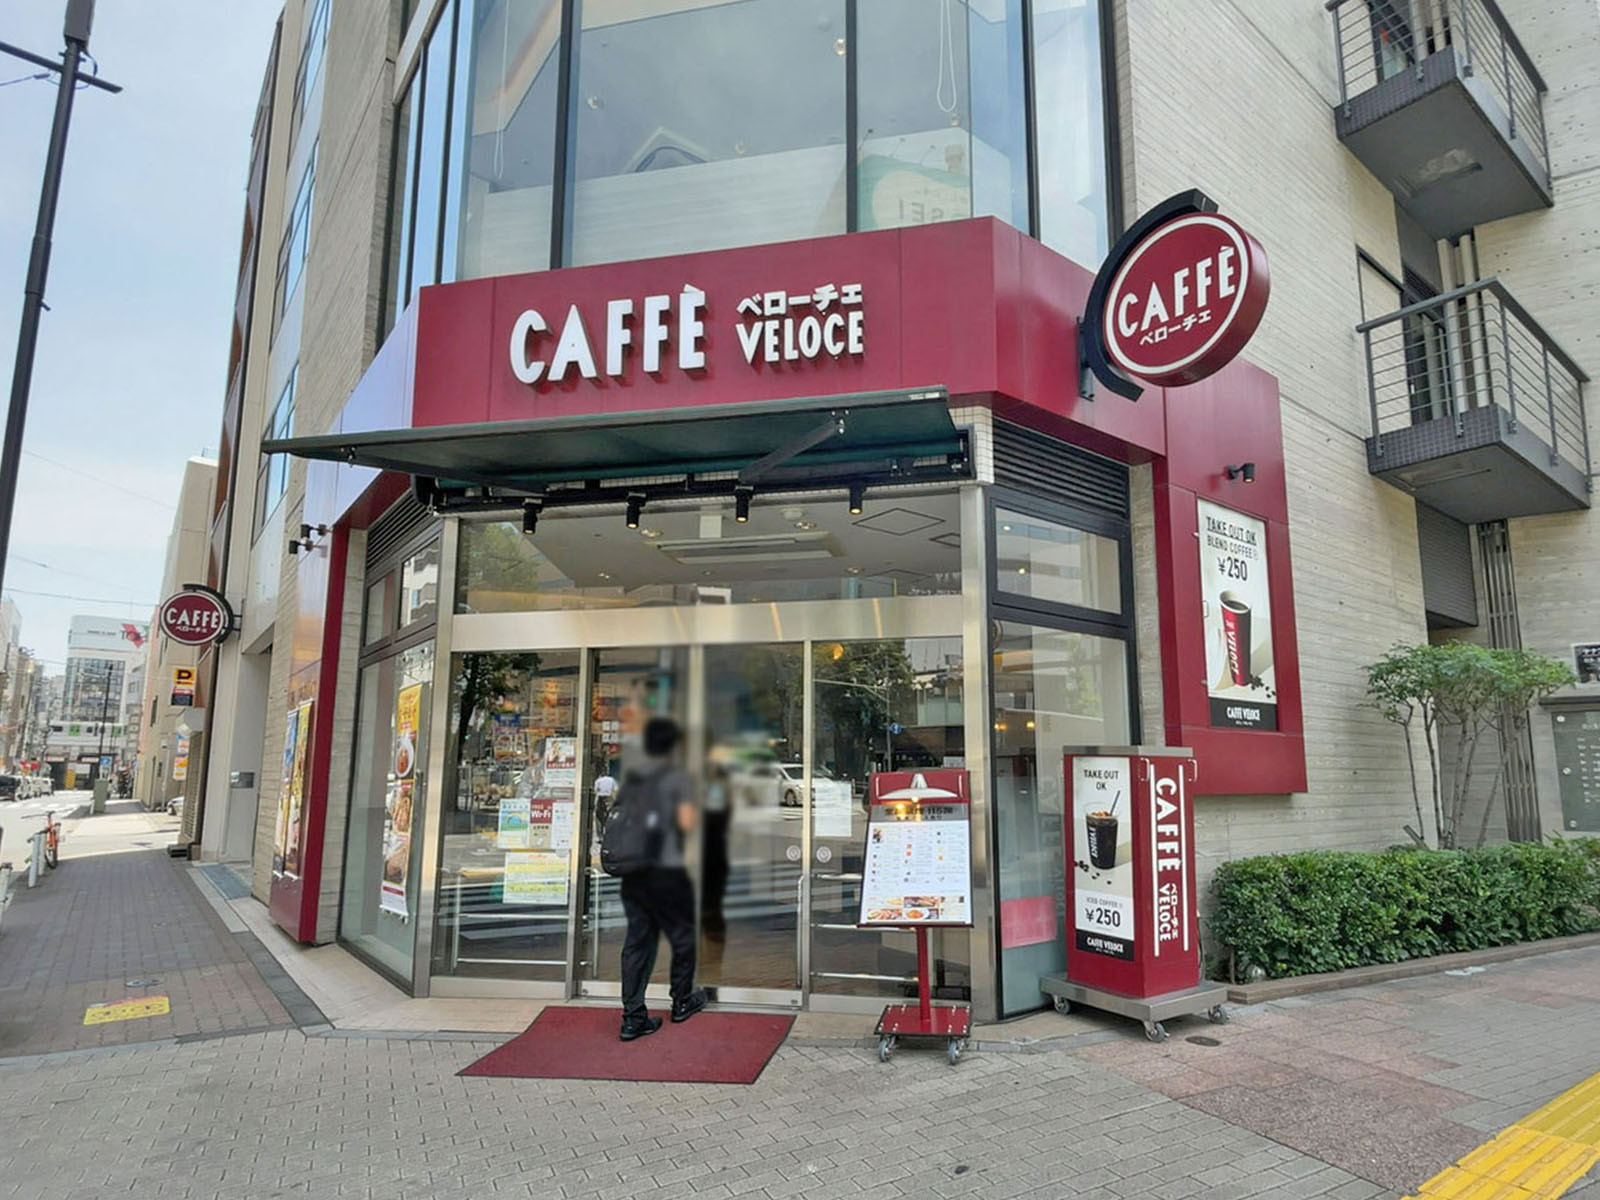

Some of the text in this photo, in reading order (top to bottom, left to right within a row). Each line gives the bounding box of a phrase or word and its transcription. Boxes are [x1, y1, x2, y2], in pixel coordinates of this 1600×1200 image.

[736, 283, 863, 315] ベローチェ
[1118, 245, 1236, 338] CAFFÈ
[509, 284, 706, 384] CAFFÈ
[736, 311, 864, 365] VELOCE
[1139, 309, 1212, 346] ベローチェ
[1206, 516, 1227, 532] TAKE
[1229, 524, 1244, 539] OUT
[1207, 535, 1228, 551] BLEND
[1230, 542, 1253, 559] COFFEE
[1217, 556, 1248, 581] ¥250
[1083, 769, 1119, 780] TAKE OUT
[1096, 781, 1107, 791] OK
[1085, 907, 1121, 927] ¥250
[1099, 899, 1118, 907] COFFEE
[1159, 882, 1171, 942] VELOCE
[1171, 882, 1179, 940] ベローチェ
